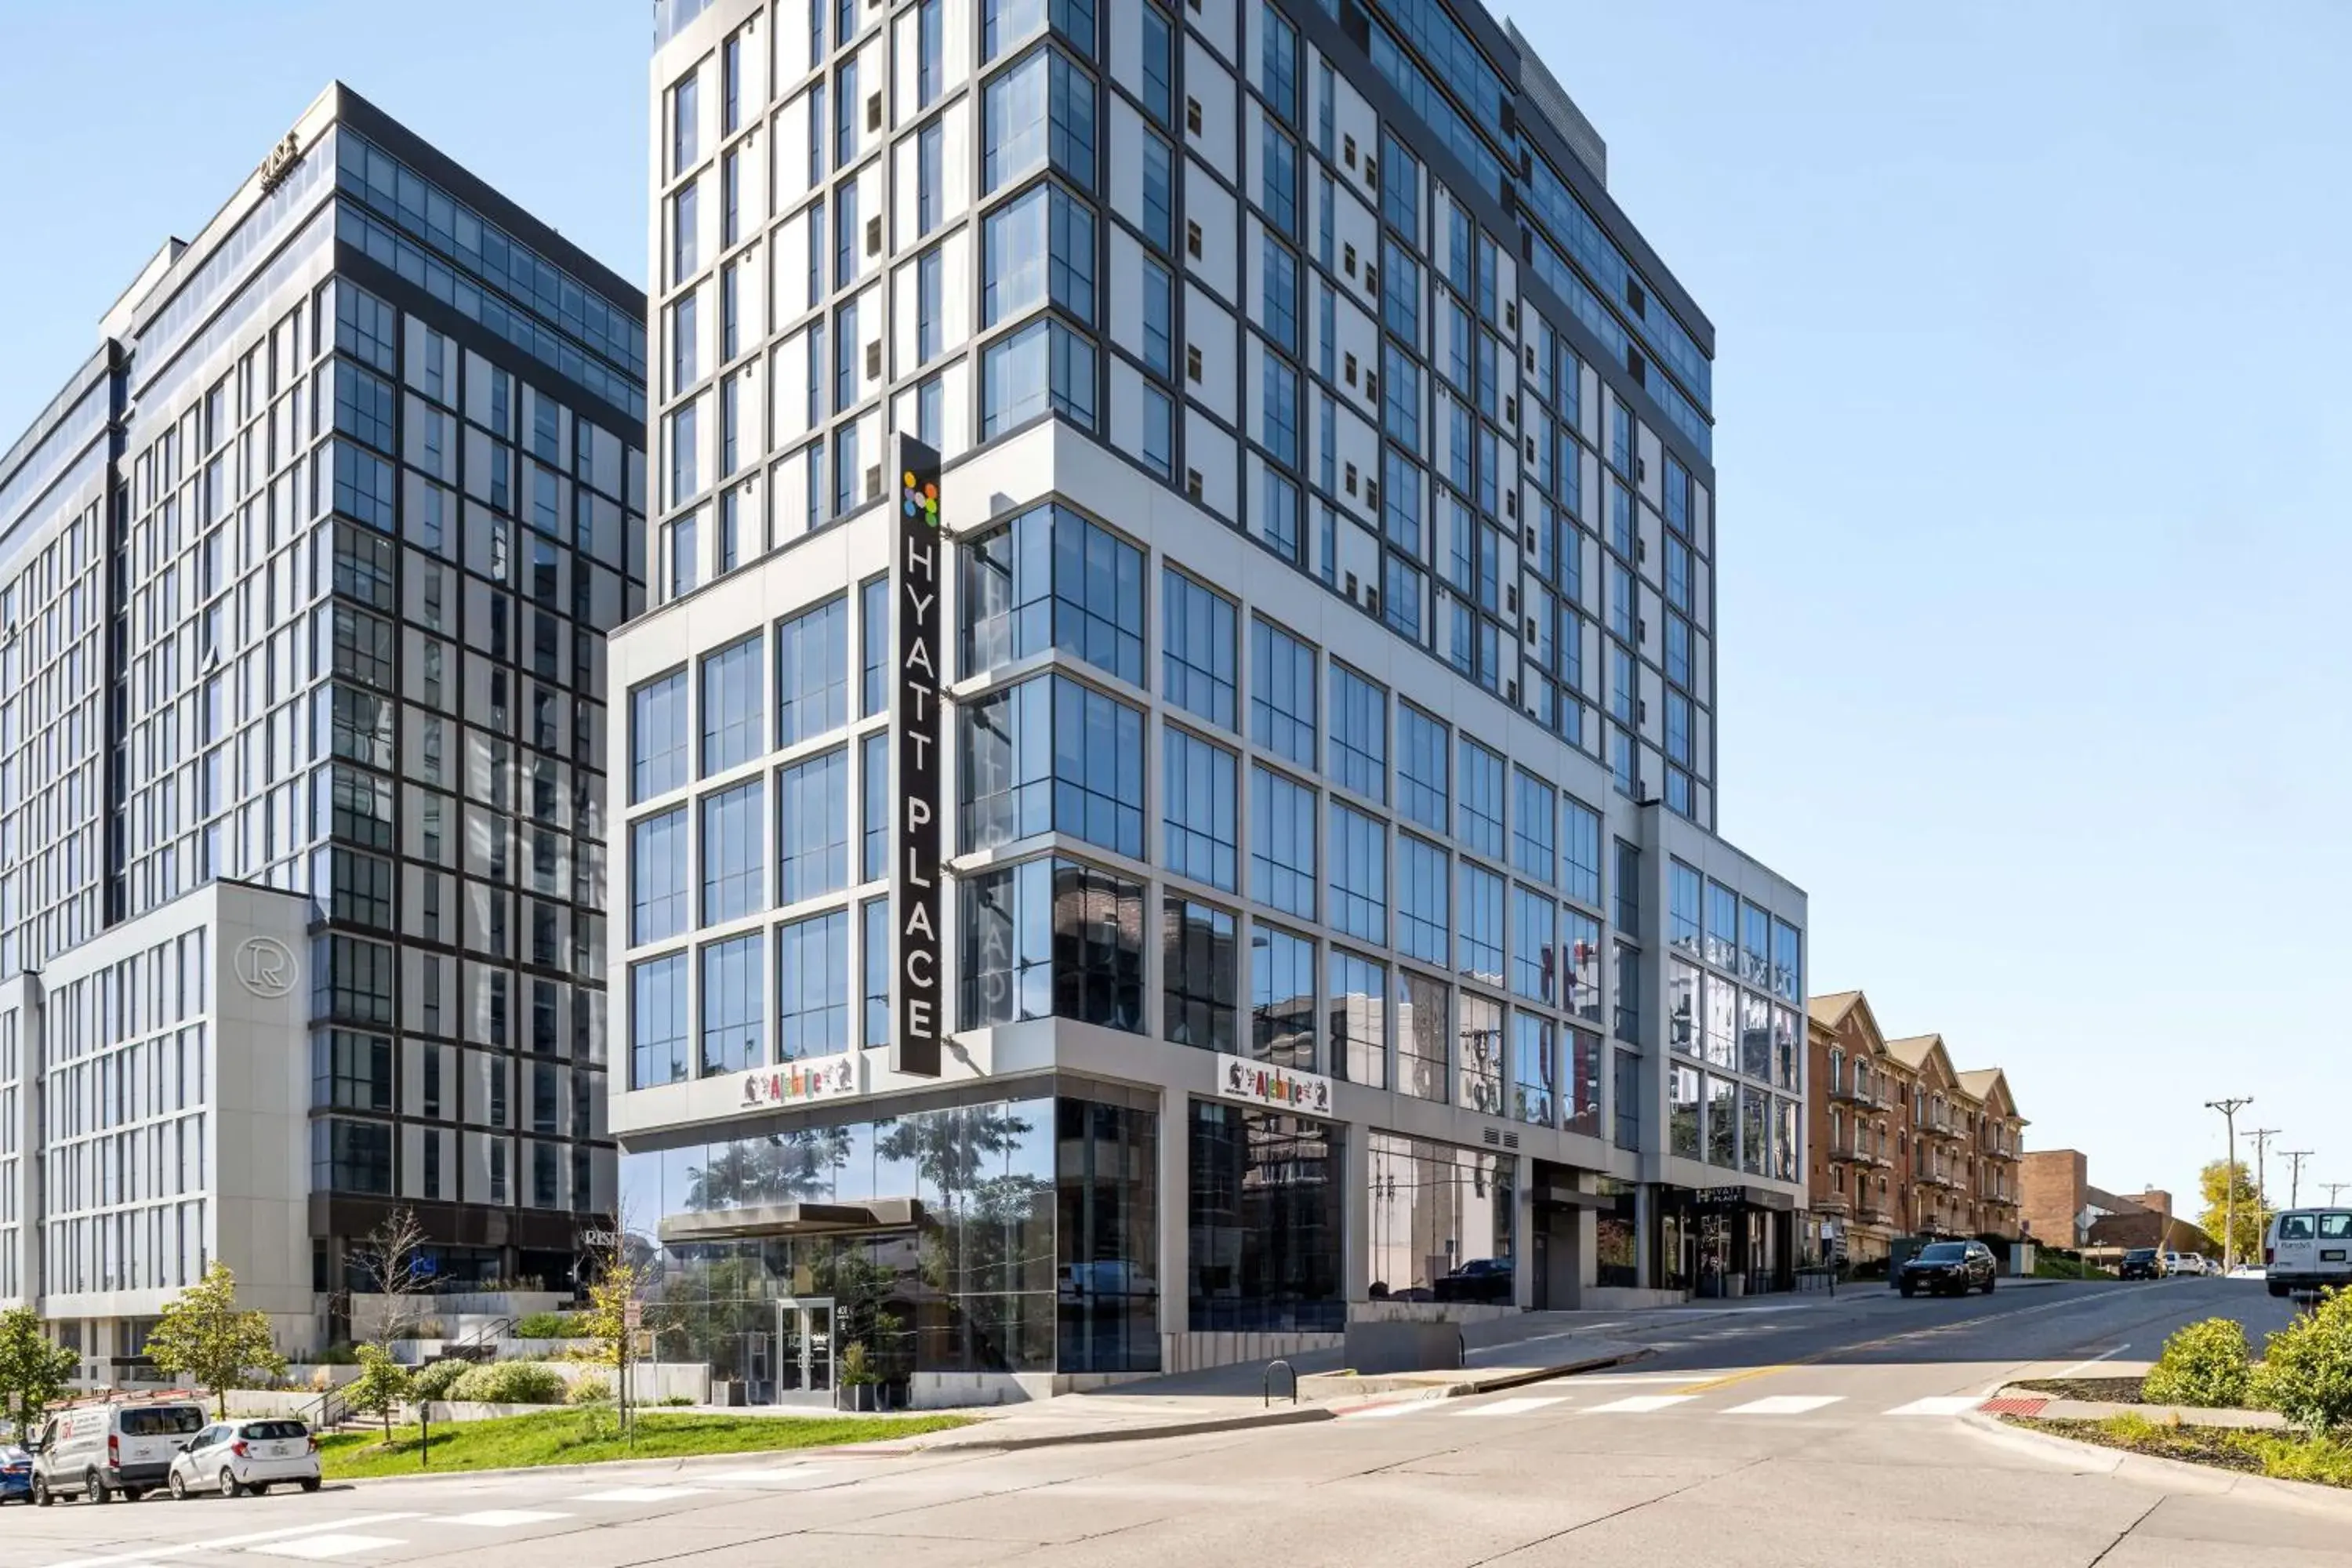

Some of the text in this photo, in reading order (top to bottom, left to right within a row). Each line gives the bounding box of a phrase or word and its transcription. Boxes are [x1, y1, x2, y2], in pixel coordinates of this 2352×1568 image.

[905, 535, 935, 1039] HYATT PLACE
[247, 943, 287, 989] R
